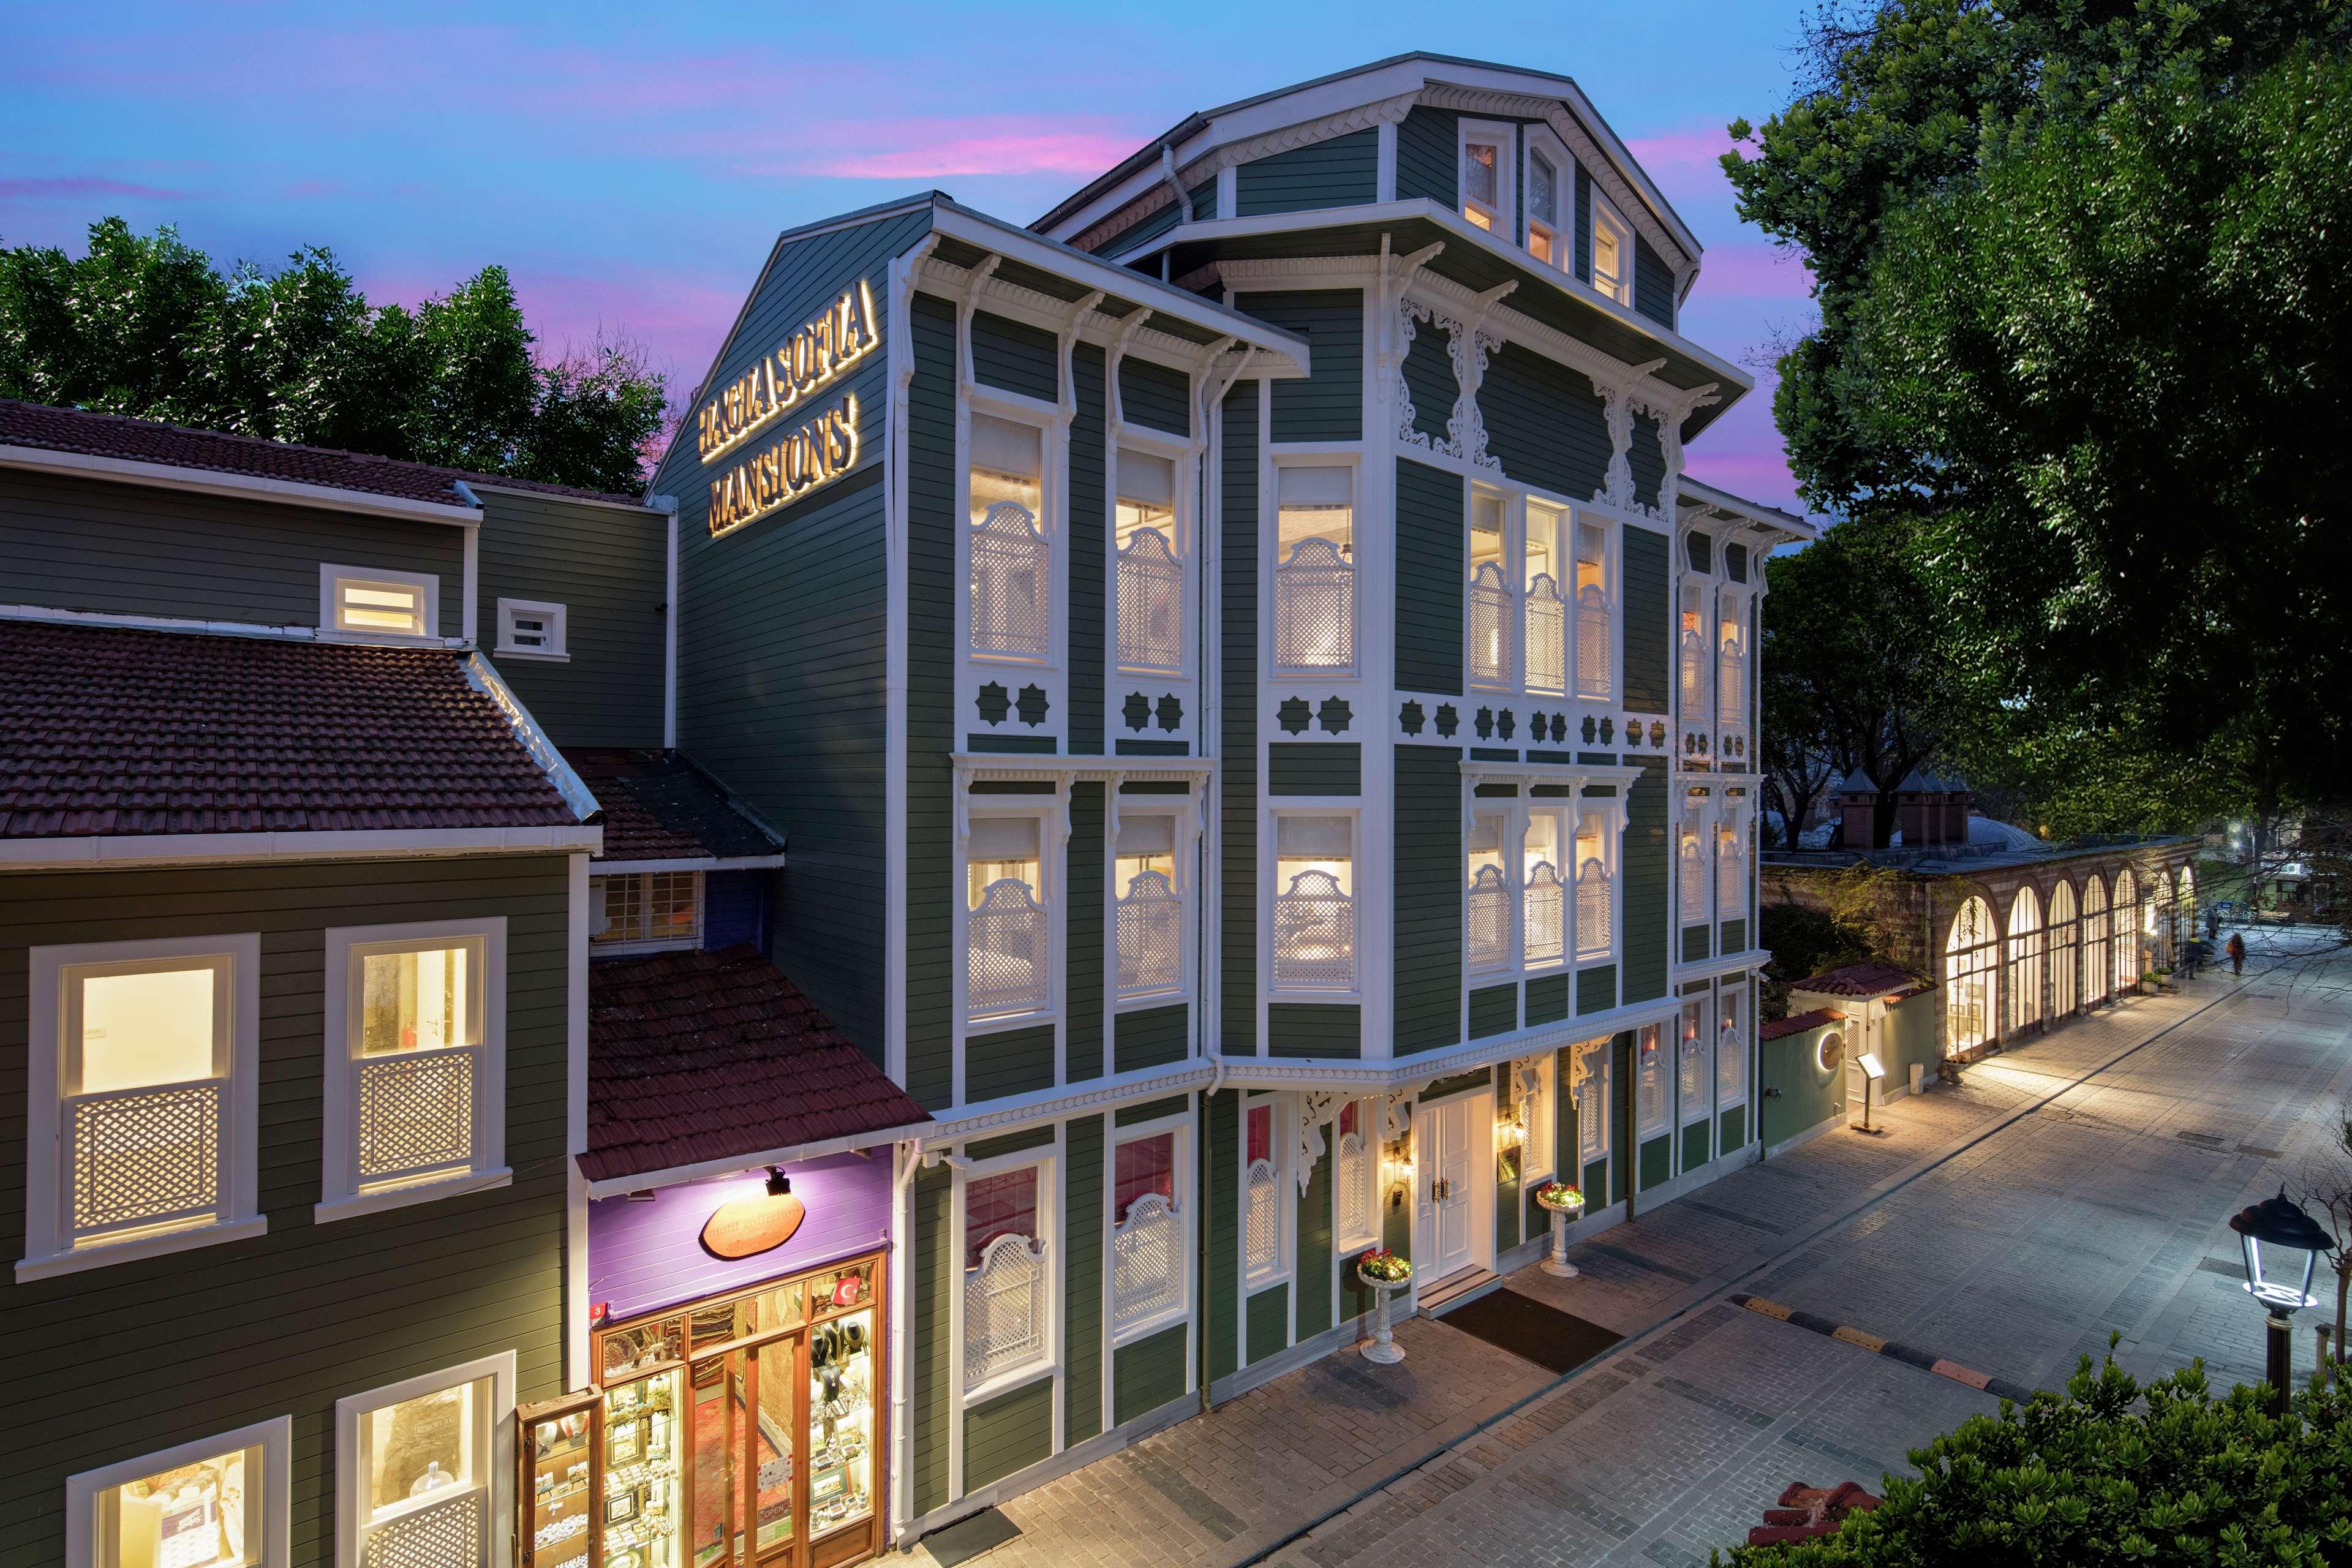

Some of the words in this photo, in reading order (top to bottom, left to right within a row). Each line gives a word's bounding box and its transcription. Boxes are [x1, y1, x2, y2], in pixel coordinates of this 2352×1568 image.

[698, 356, 774, 462] HAGIA
[775, 281, 876, 405] SOFIA
[707, 395, 854, 536] MANSIONS
[595, 1306, 600, 1315] 3
[764, 1504, 783, 1518] OPEN
